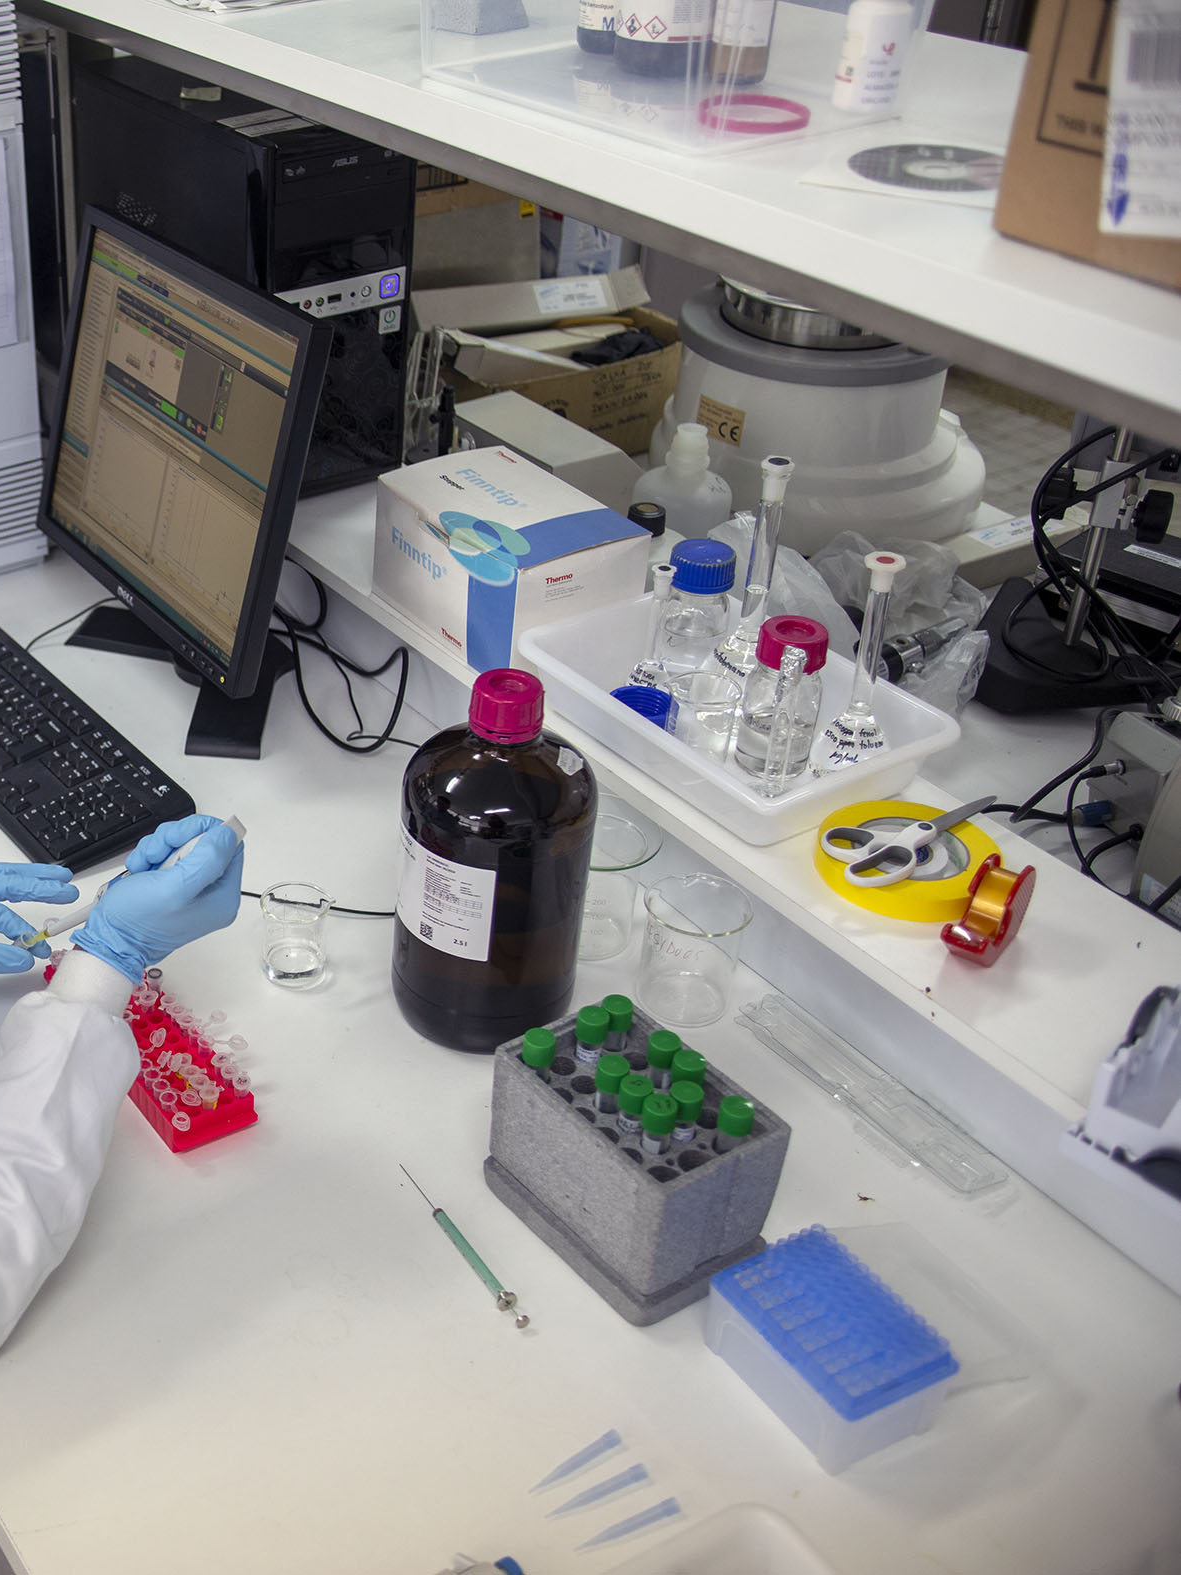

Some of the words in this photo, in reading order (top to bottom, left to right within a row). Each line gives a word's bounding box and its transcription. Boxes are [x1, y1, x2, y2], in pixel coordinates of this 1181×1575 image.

[331, 155, 359, 168] ASUS
[495, 450, 518, 464] Thermo
[439, 474, 466, 491] Stepper
[545, 571, 574, 585] Thermo
[117, 585, 134, 607] DELL
[441, 627, 463, 649] Thermo
[858, 727, 878, 738] fenol
